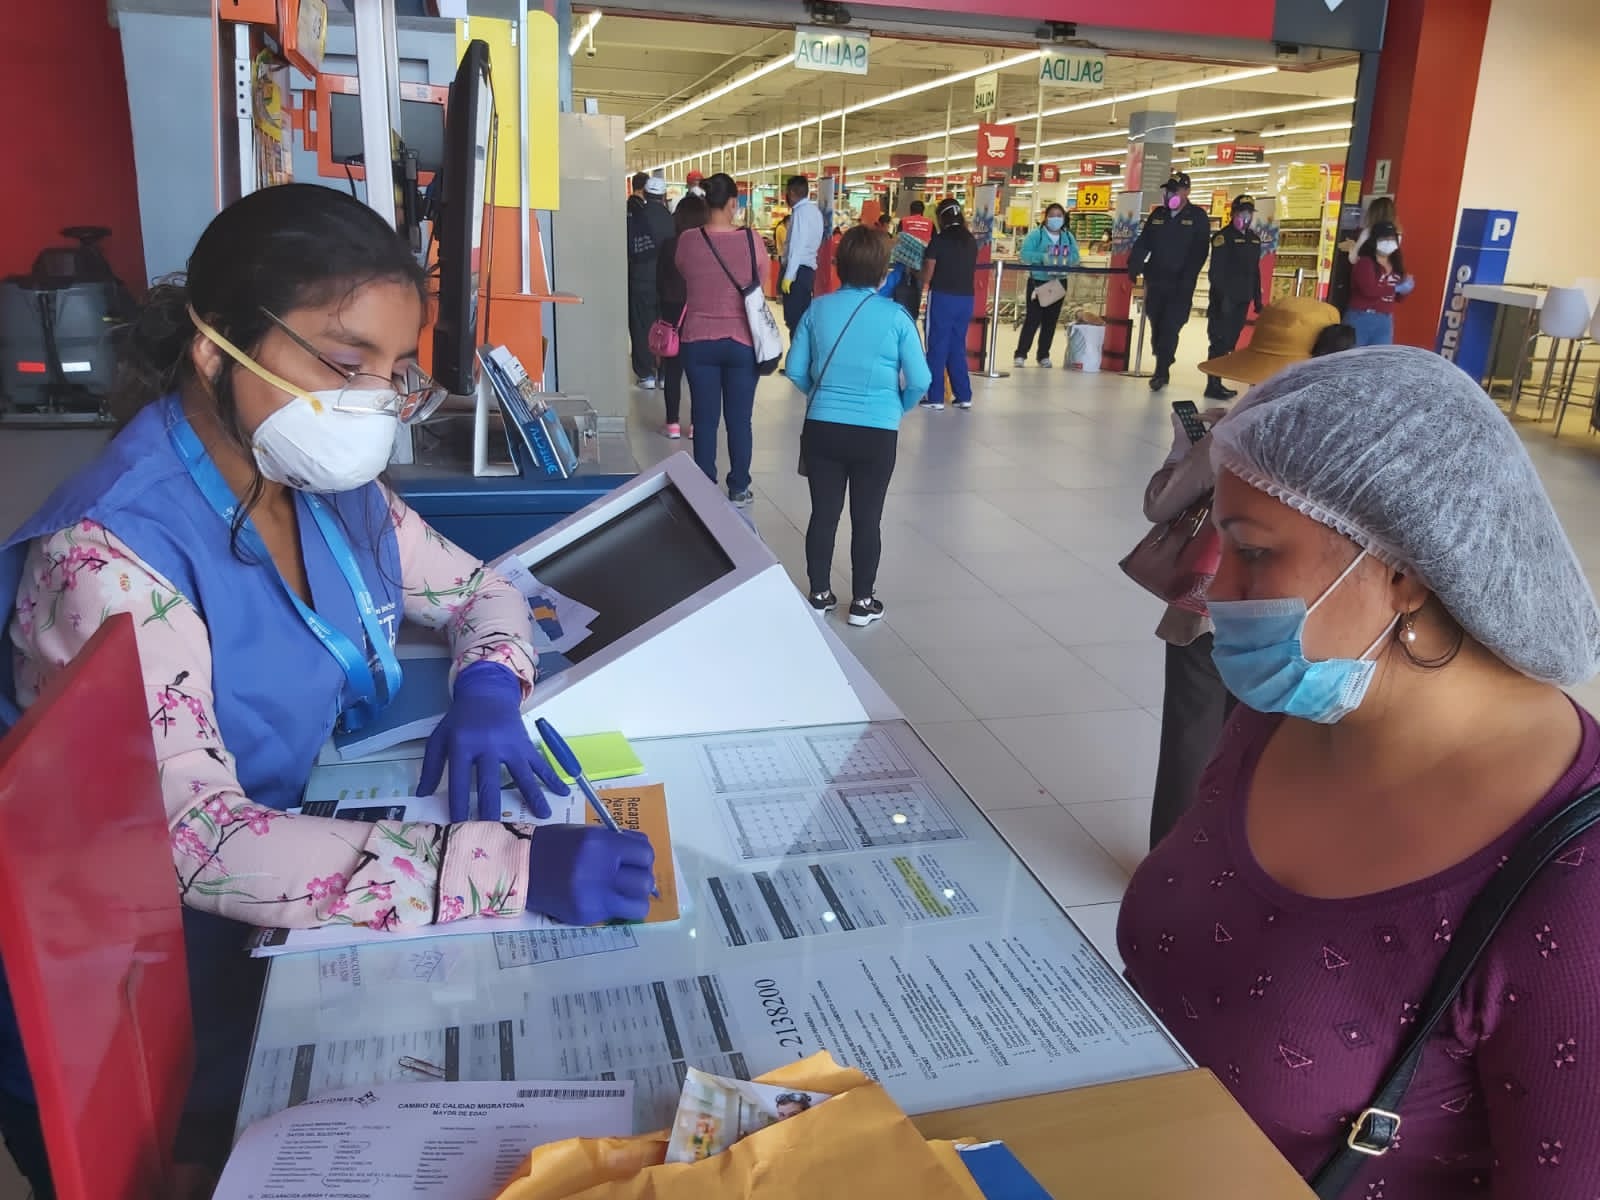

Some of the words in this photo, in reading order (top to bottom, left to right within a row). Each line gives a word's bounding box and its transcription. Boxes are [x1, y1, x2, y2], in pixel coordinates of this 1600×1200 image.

[976, 90, 995, 109] SALIDA
[1221, 149, 1232, 159] 17
[1380, 163, 1386, 179] 1
[1085, 193, 1098, 205] 59
[1491, 218, 1511, 241] P
[1441, 265, 1471, 361] andero
[625, 797, 640, 829] Recarga
[754, 979, 803, 1048] 2138200
